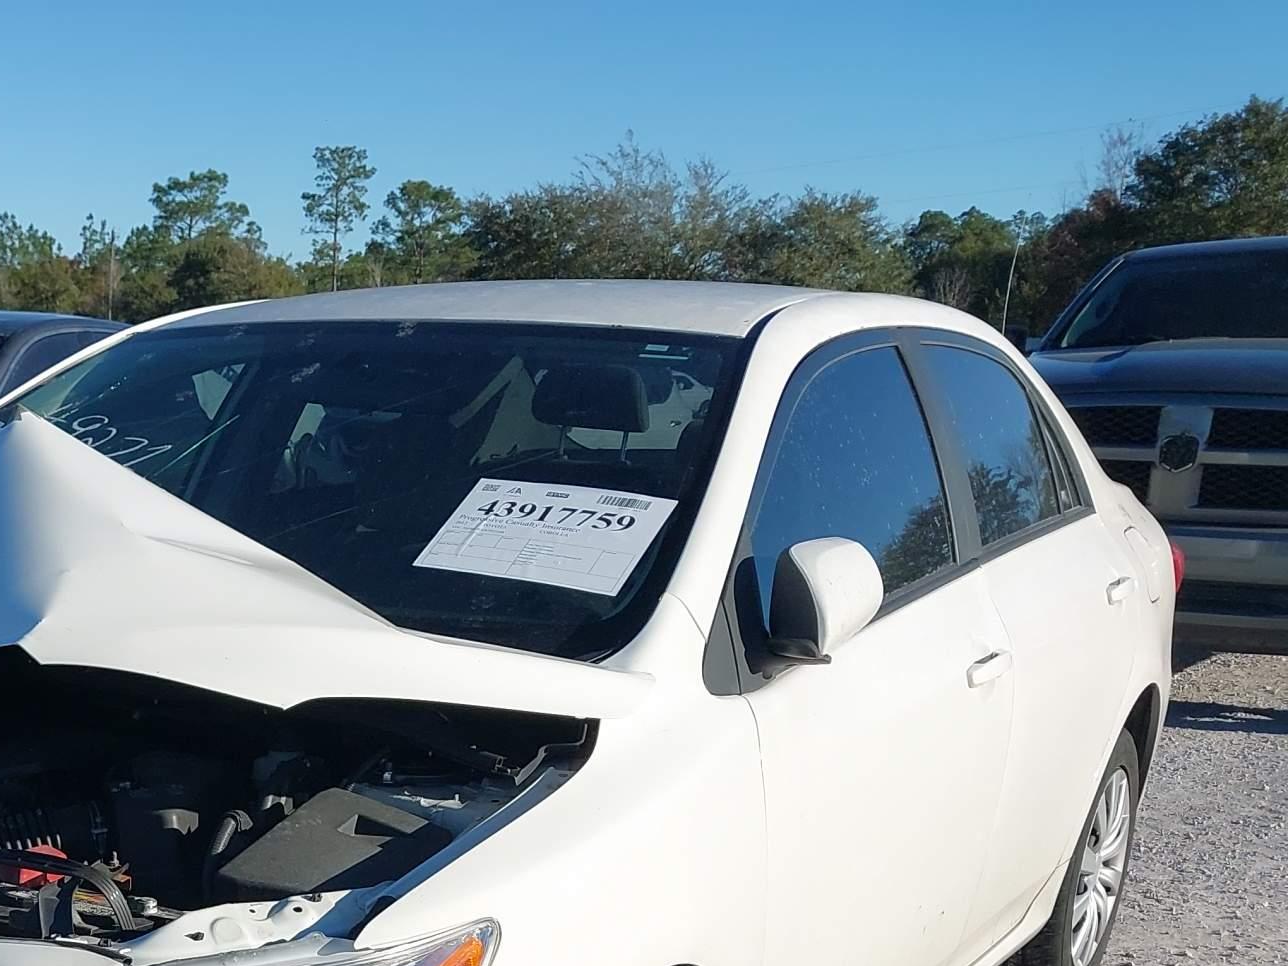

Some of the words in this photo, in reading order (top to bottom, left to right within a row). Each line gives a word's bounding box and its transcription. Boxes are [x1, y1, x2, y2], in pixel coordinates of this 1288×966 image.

[477, 499, 636, 532] 43917759
[505, 518, 541, 529] Casualty
[541, 522, 581, 533] Insurance
